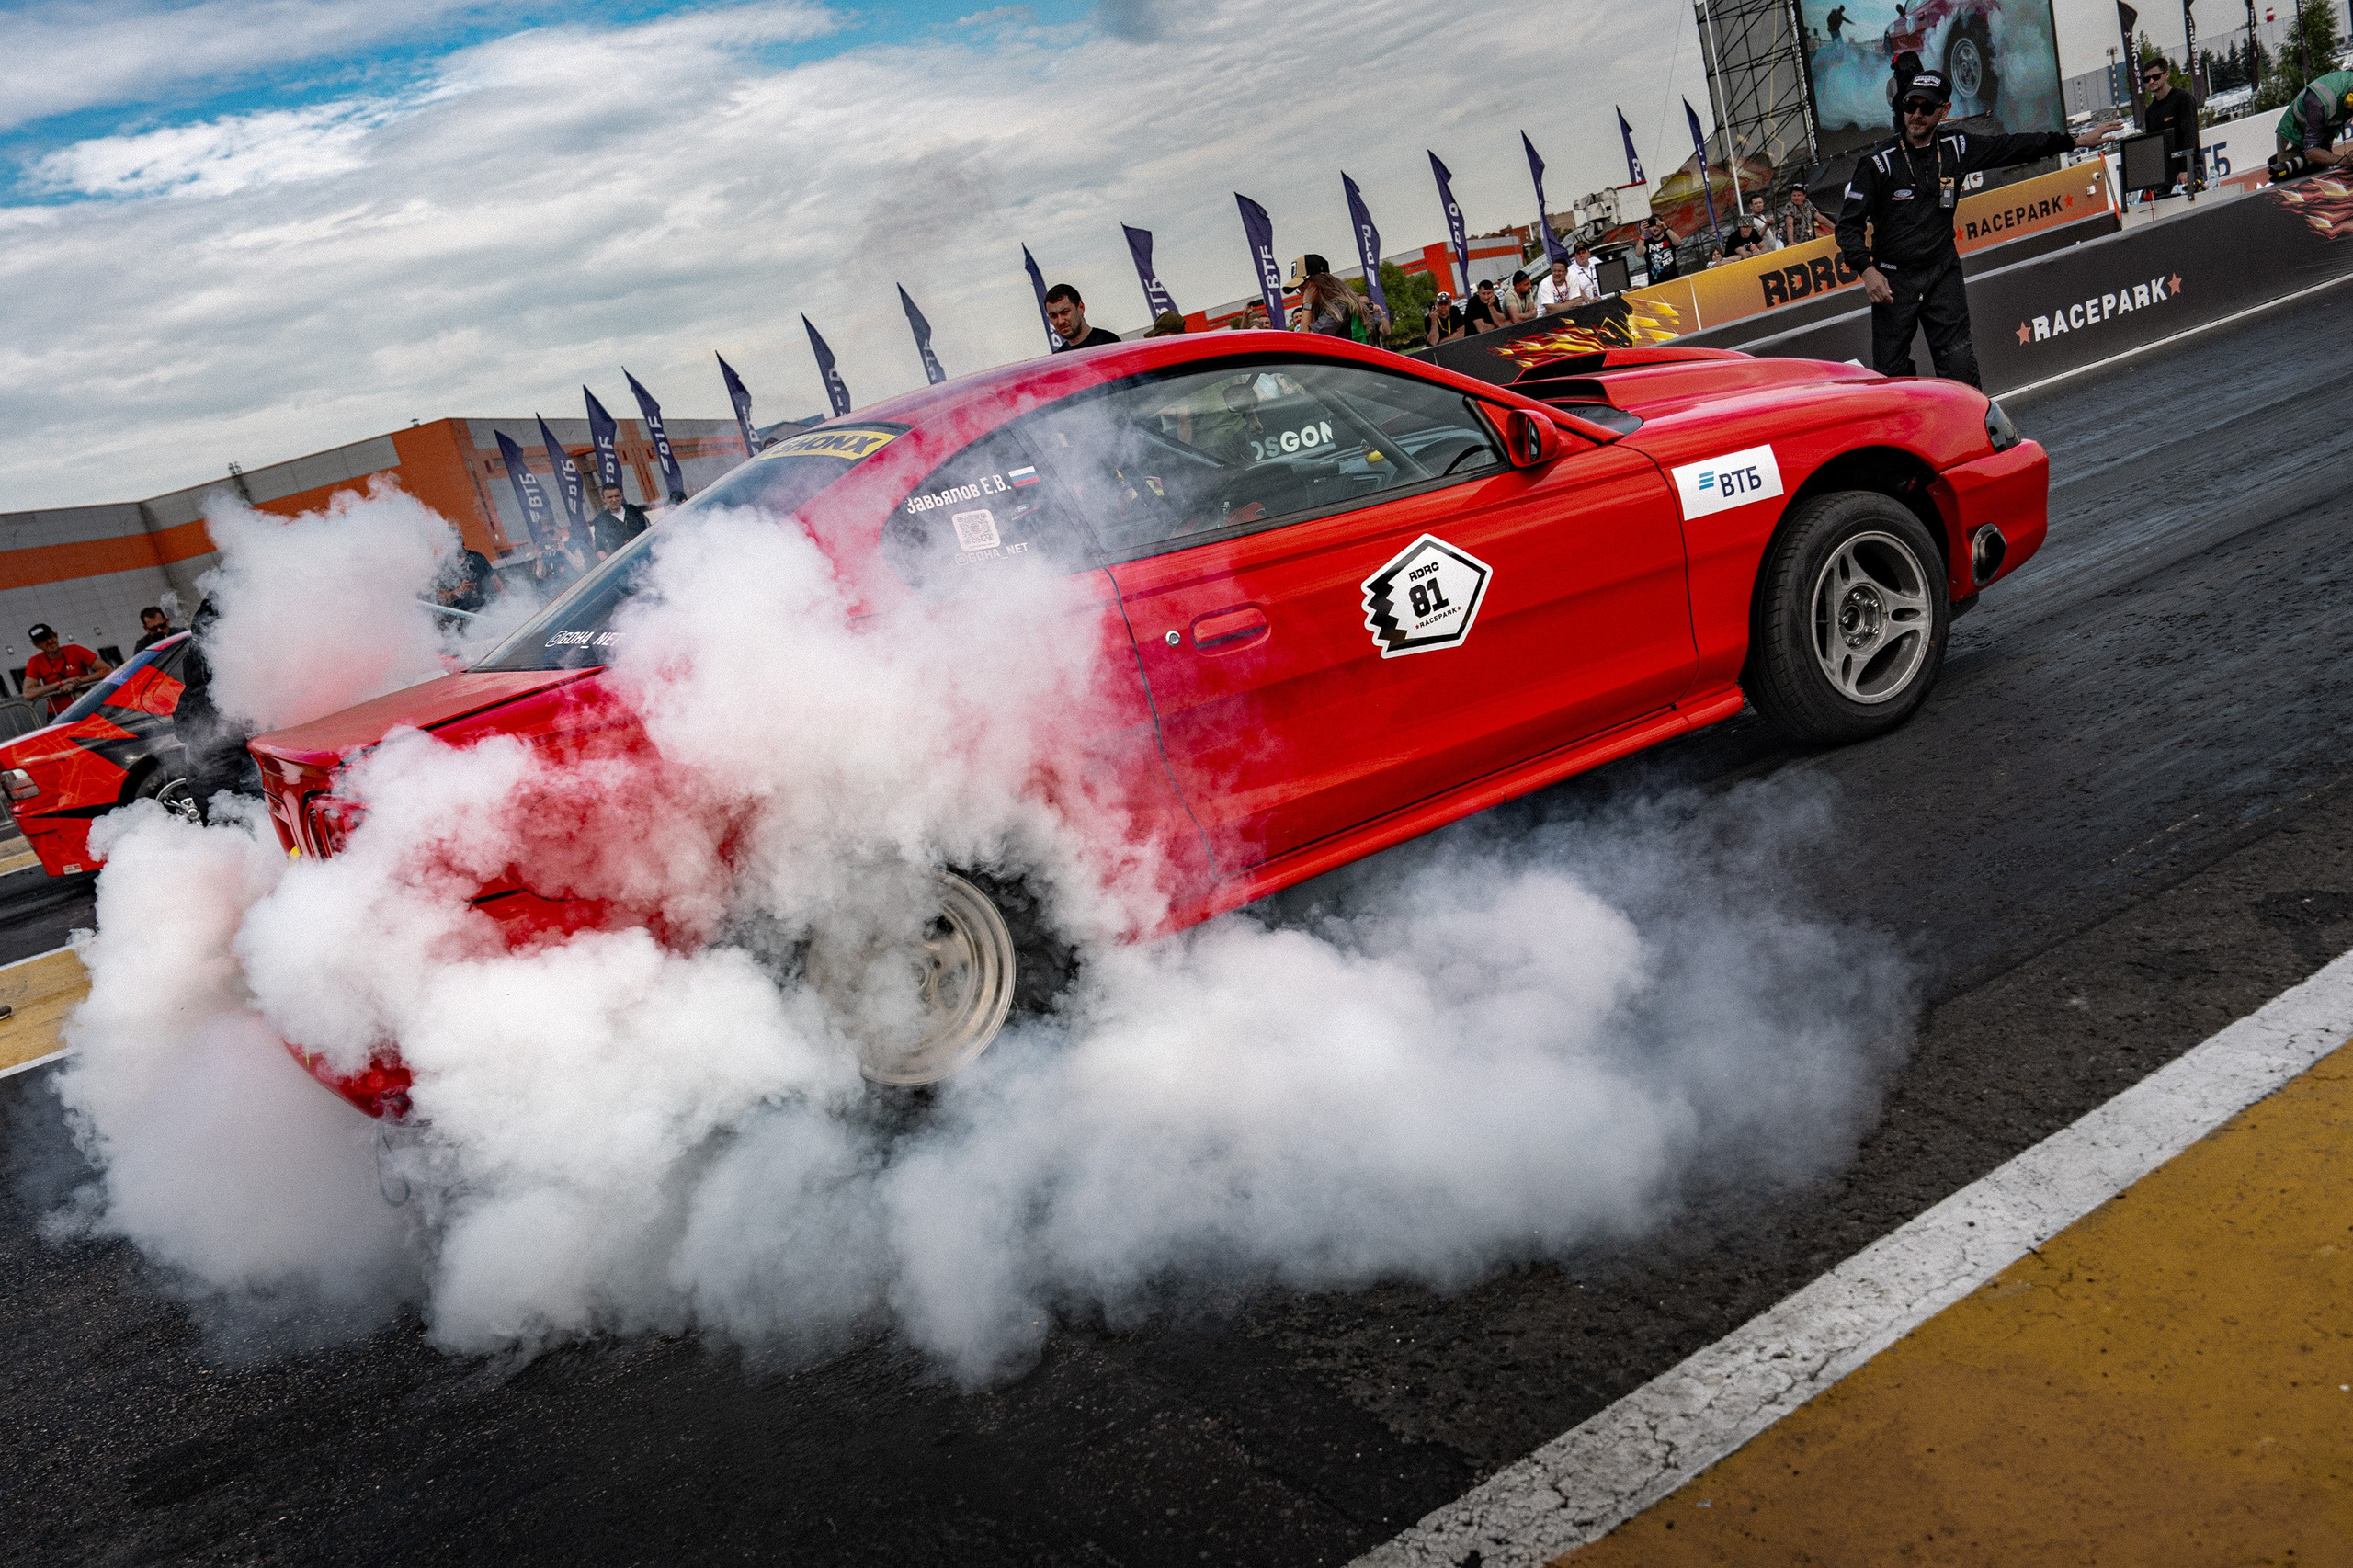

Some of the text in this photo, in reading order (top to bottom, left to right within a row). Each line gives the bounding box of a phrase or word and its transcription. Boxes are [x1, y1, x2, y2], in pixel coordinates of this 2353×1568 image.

[1966, 194, 2063, 241] RACEPARK
[2031, 276, 2167, 342] RACEPARK
[979, 474, 1012, 495] Е.В.
[1719, 465, 1762, 498] ВТБ
[1408, 562, 1440, 583] RDRC
[1409, 577, 1449, 619] 81
[1419, 607, 1458, 629] RACEPARK
